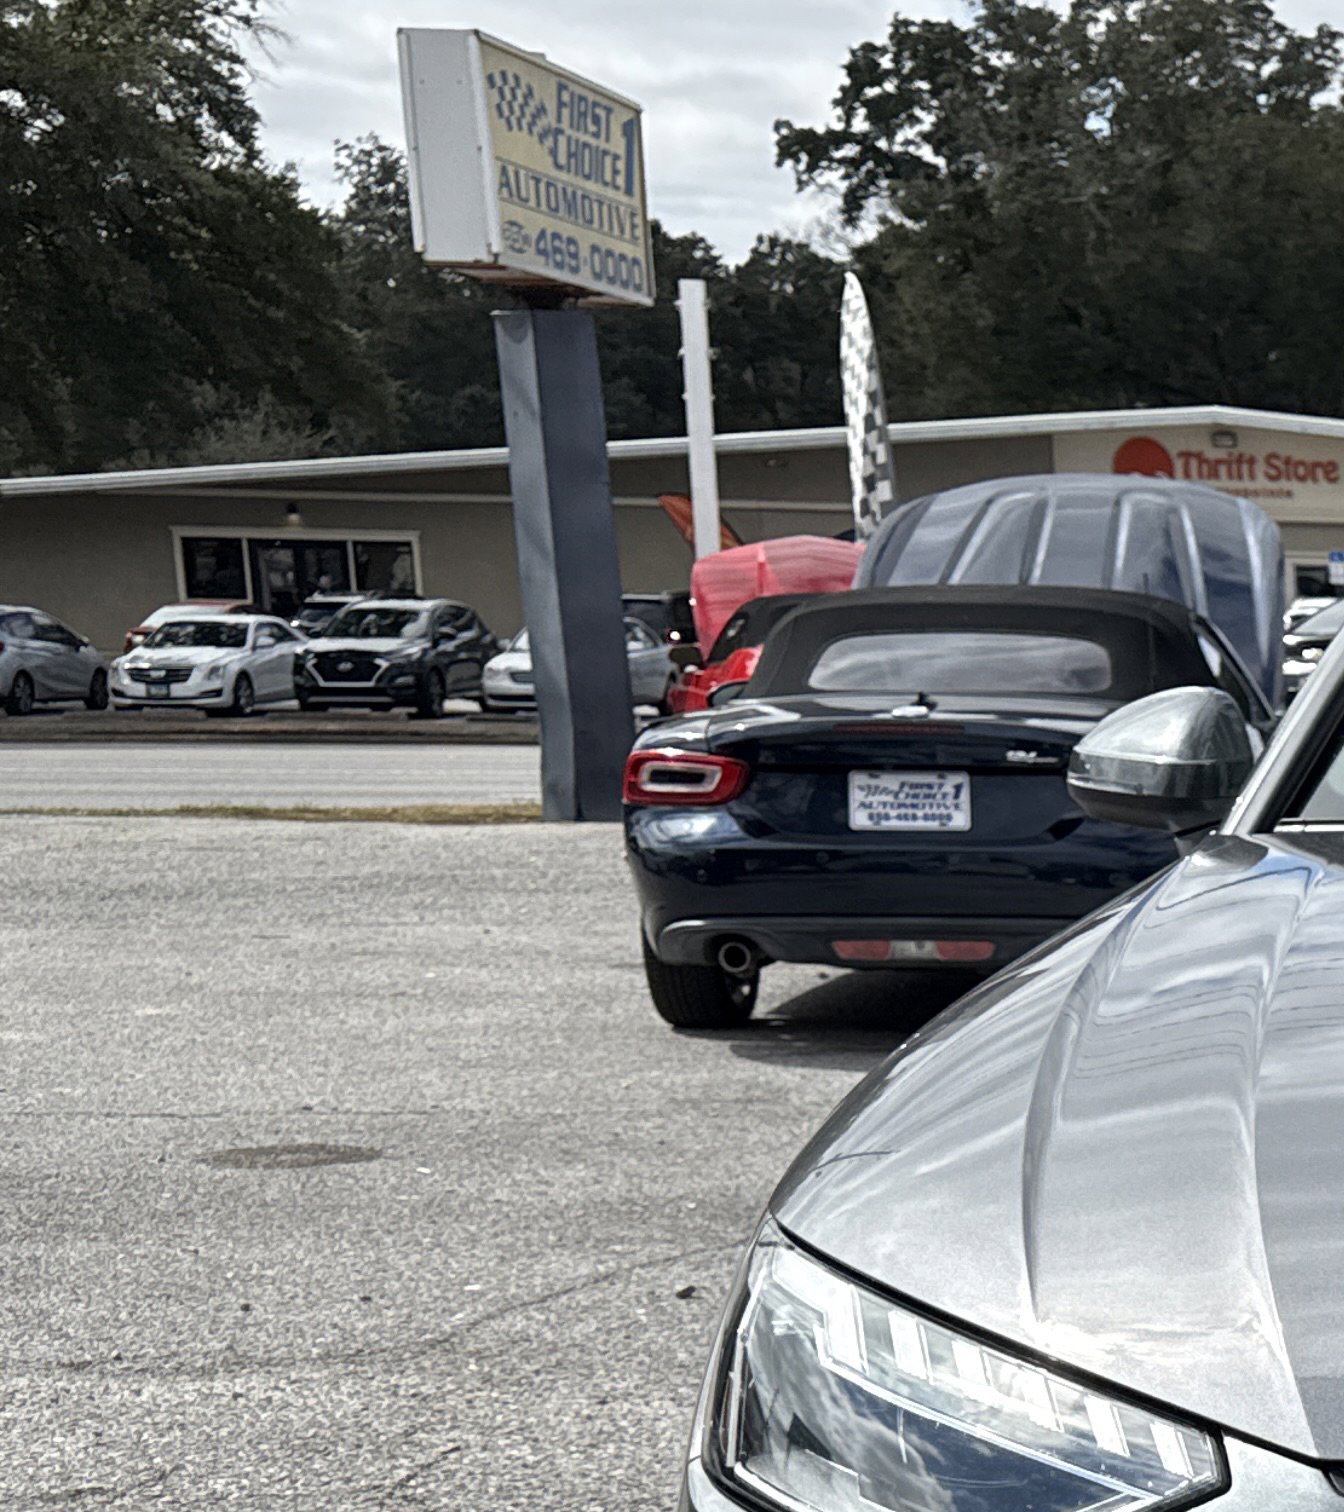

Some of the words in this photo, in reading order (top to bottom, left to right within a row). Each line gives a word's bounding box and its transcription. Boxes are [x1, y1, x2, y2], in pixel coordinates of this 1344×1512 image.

[556, 79, 613, 143] FIRST
[551, 126, 621, 190] CHOICE
[622, 117, 636, 198] 1
[499, 164, 641, 242] AUTOMOTIVE
[1177, 450, 1256, 481] Thrift
[1264, 451, 1340, 483] Store
[858, 801, 962, 811] AUTOMOTIVE
